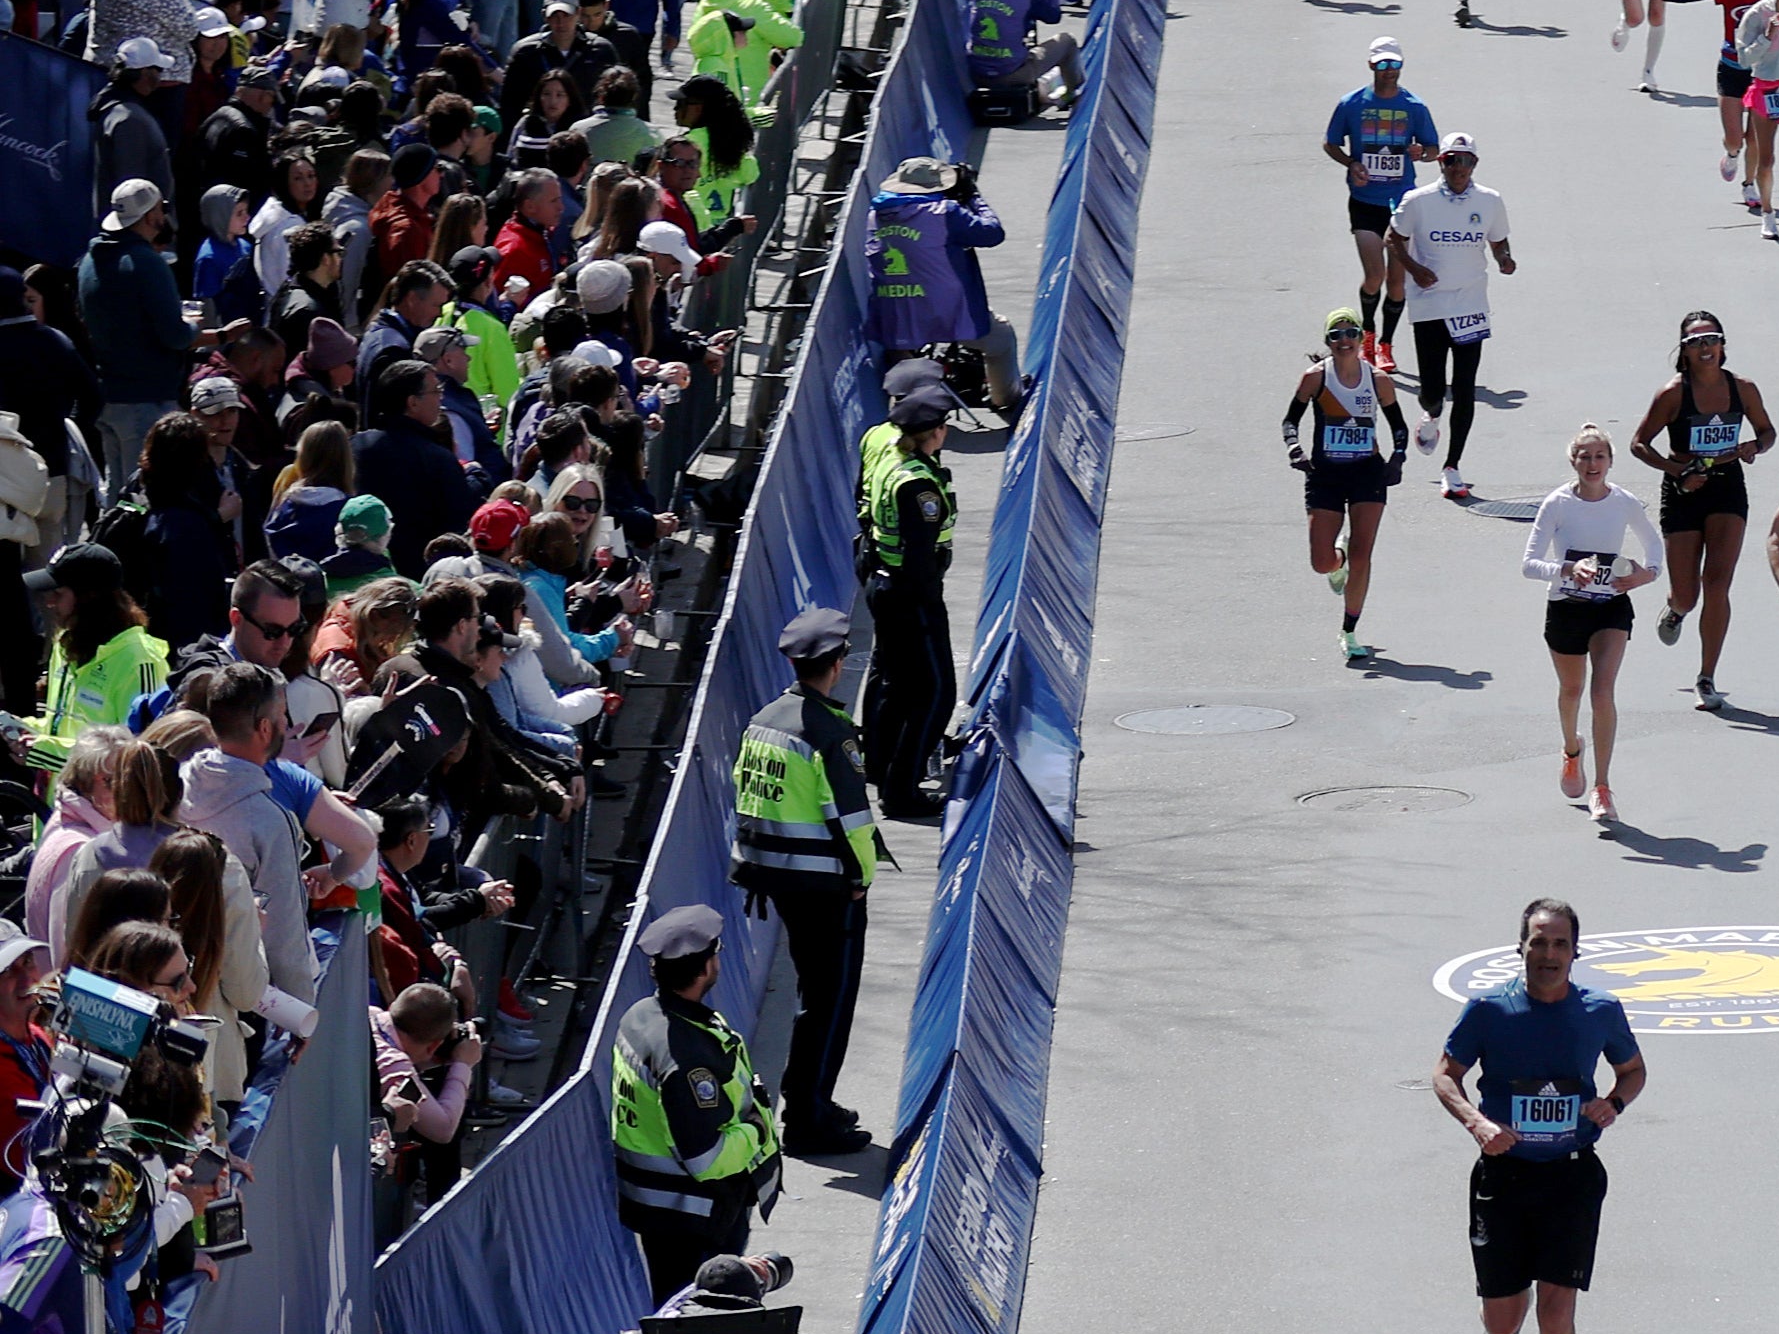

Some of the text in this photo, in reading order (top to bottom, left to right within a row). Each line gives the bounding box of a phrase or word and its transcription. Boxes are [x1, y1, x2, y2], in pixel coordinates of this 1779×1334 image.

[1368, 155, 1401, 170] 11636
[876, 283, 926, 299] MEDIA
[1328, 428, 1368, 445] 17984
[1696, 426, 1735, 444] 16345
[1667, 1000, 1725, 1009] EST.
[1520, 1097, 1574, 1124] 16061
